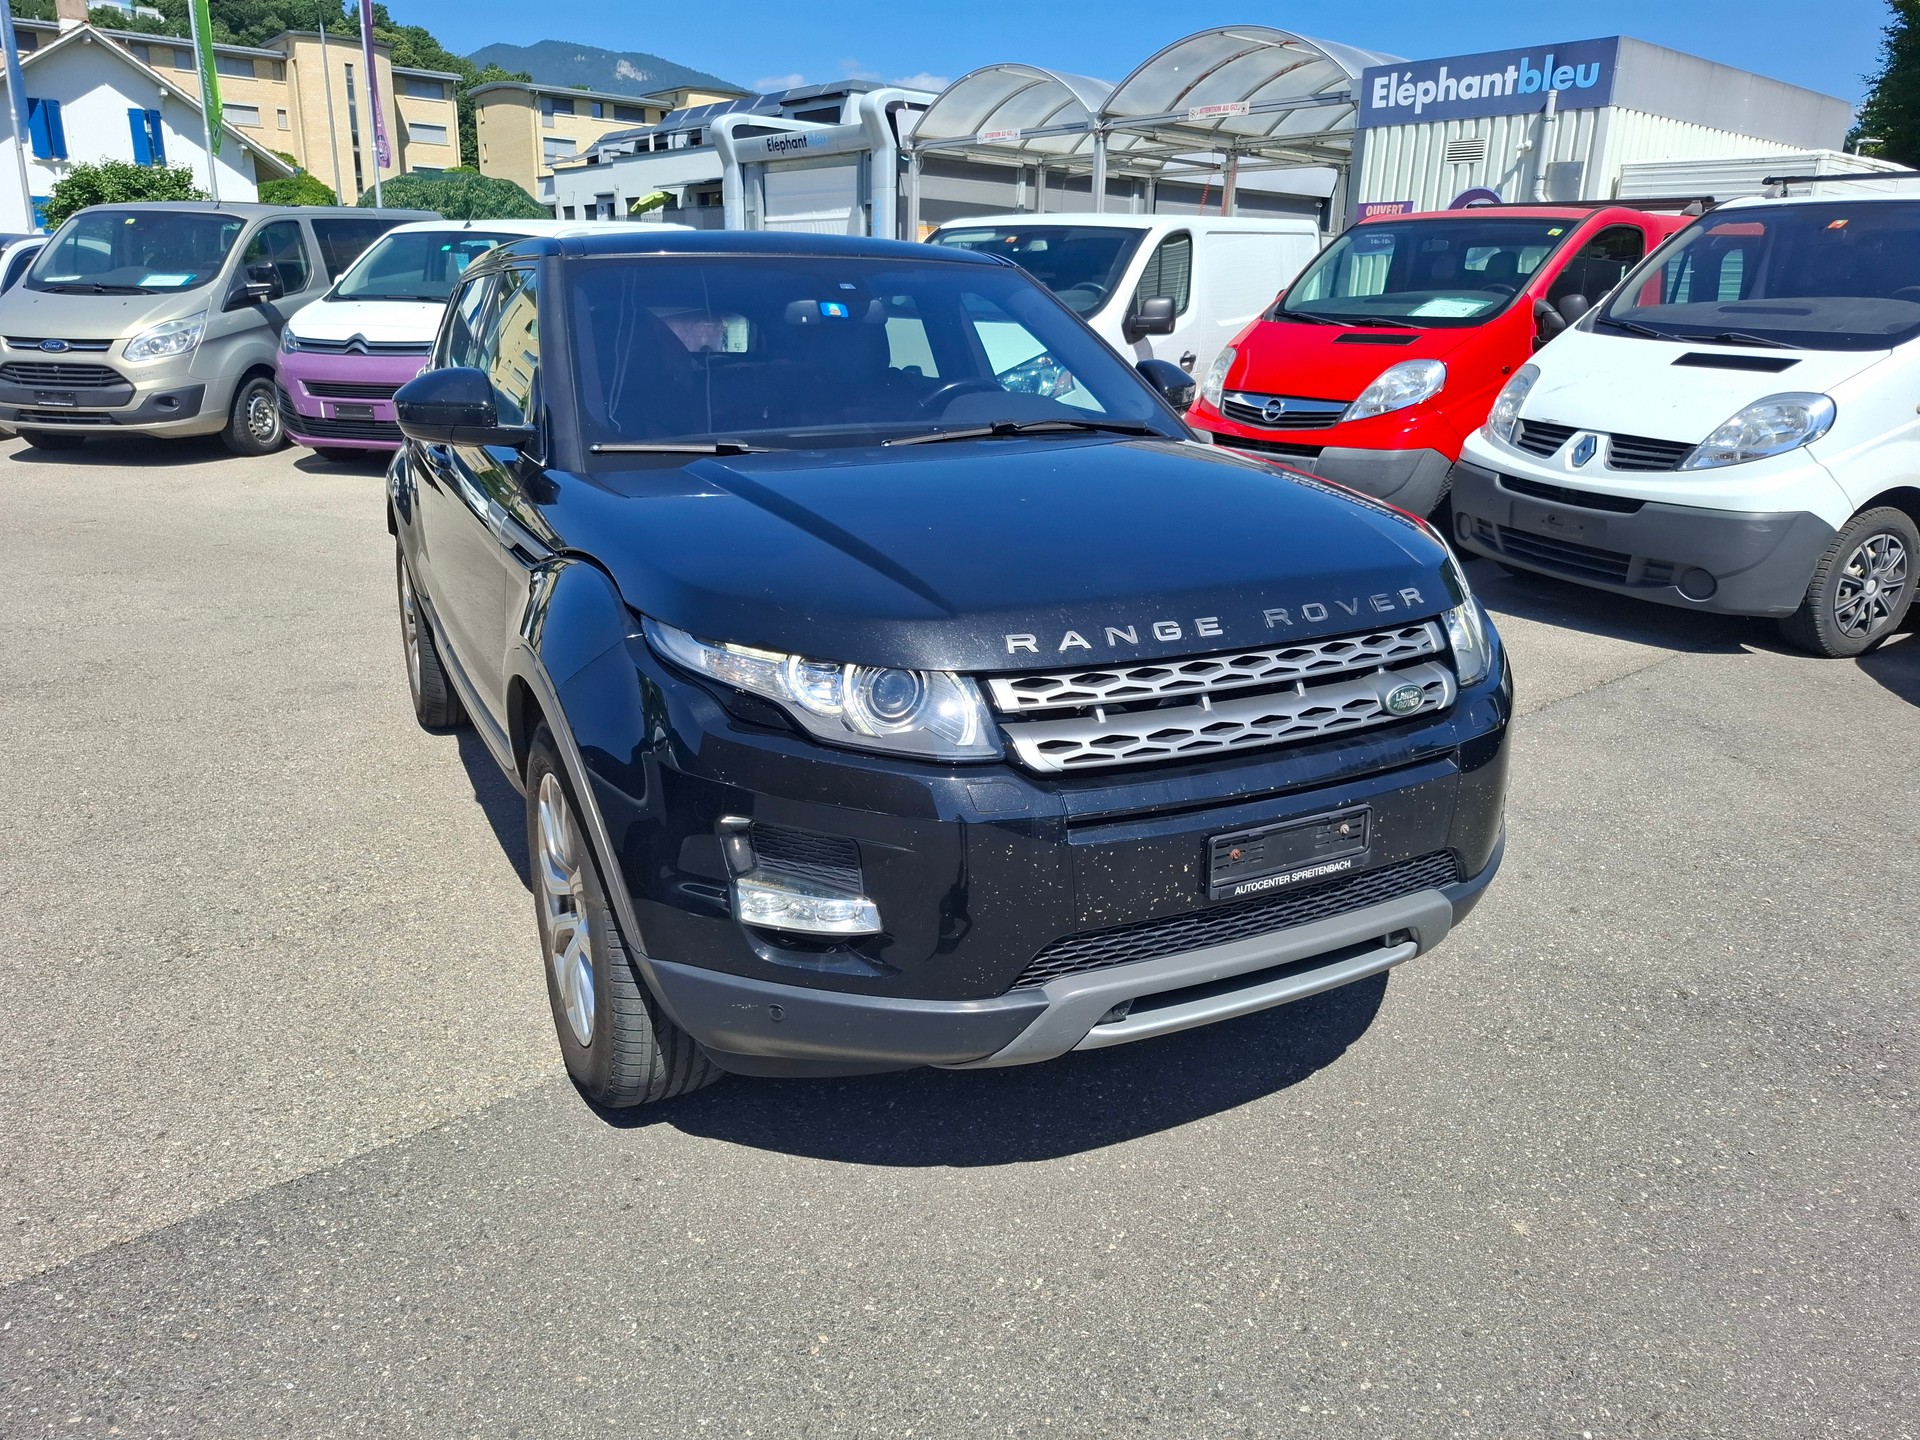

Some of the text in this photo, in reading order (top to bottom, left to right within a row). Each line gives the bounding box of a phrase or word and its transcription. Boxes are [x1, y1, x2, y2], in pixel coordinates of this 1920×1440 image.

[1366, 204, 1404, 216] OUVERT
[1005, 587, 1425, 654] RANGE ROVER
[1395, 690, 1414, 702] LAND
[1397, 697, 1420, 710] ROVER
[1234, 860, 1351, 896] AUTOCENTER SPREITENBACH
